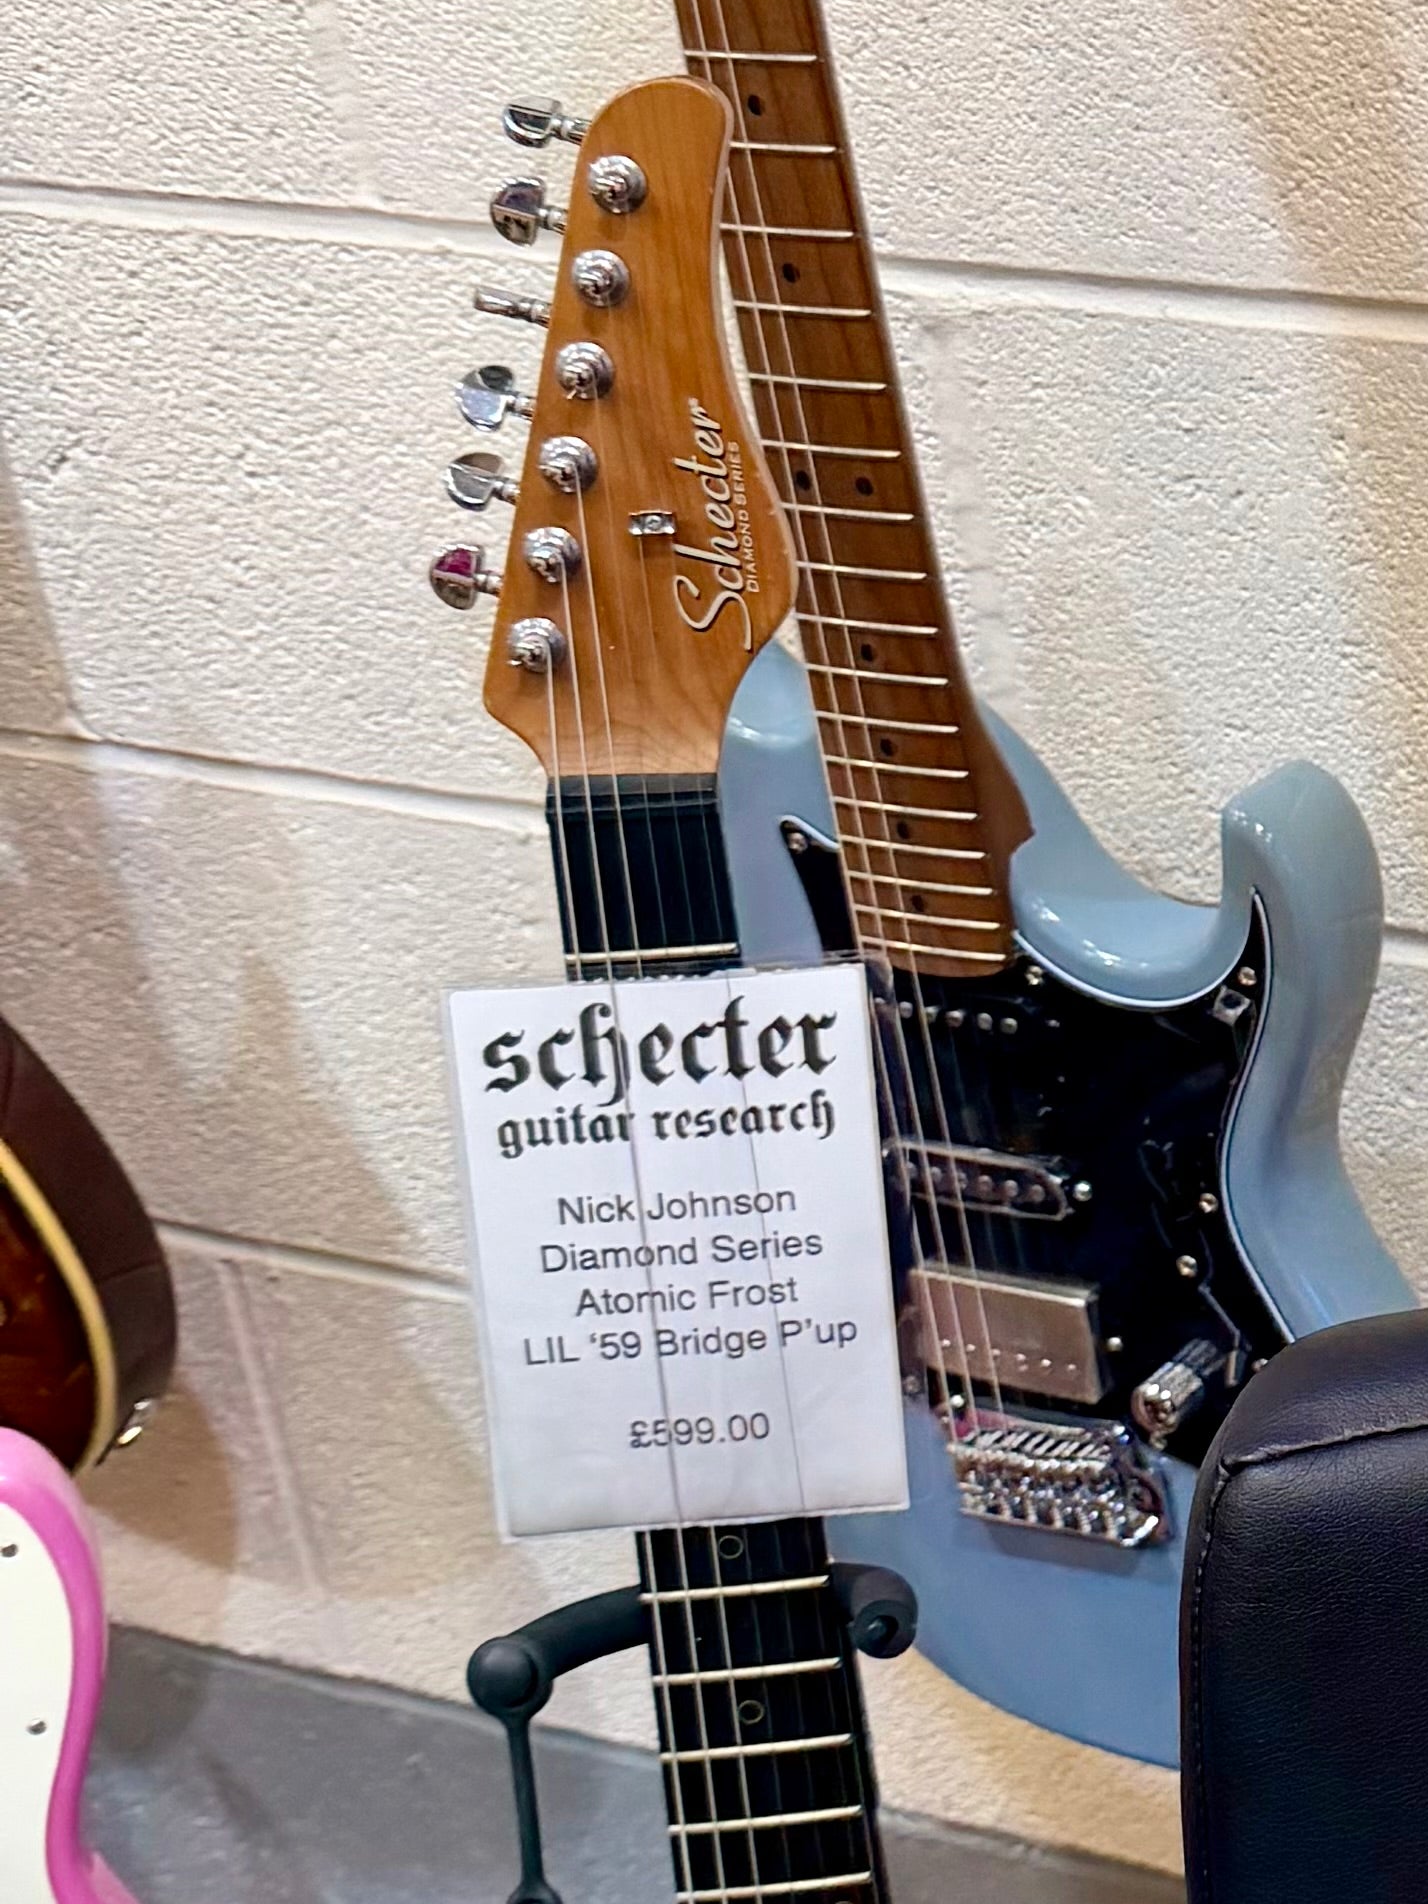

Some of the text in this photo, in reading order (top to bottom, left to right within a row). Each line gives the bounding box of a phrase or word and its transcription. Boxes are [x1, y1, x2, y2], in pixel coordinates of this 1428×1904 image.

[672, 399, 752, 651] Schecter
[728, 441, 760, 593] DIAMOND SERIES
[482, 995, 839, 1107] schecter
[497, 1088, 836, 1159] guitar research
[558, 1190, 797, 1226] Nick Johnson
[540, 1232, 824, 1274] Diamond Series
[575, 1277, 799, 1317] Atomic Frost
[523, 1335, 581, 1366] LIL
[655, 1326, 767, 1359] Bridge
[629, 1412, 770, 1448] £599.00
